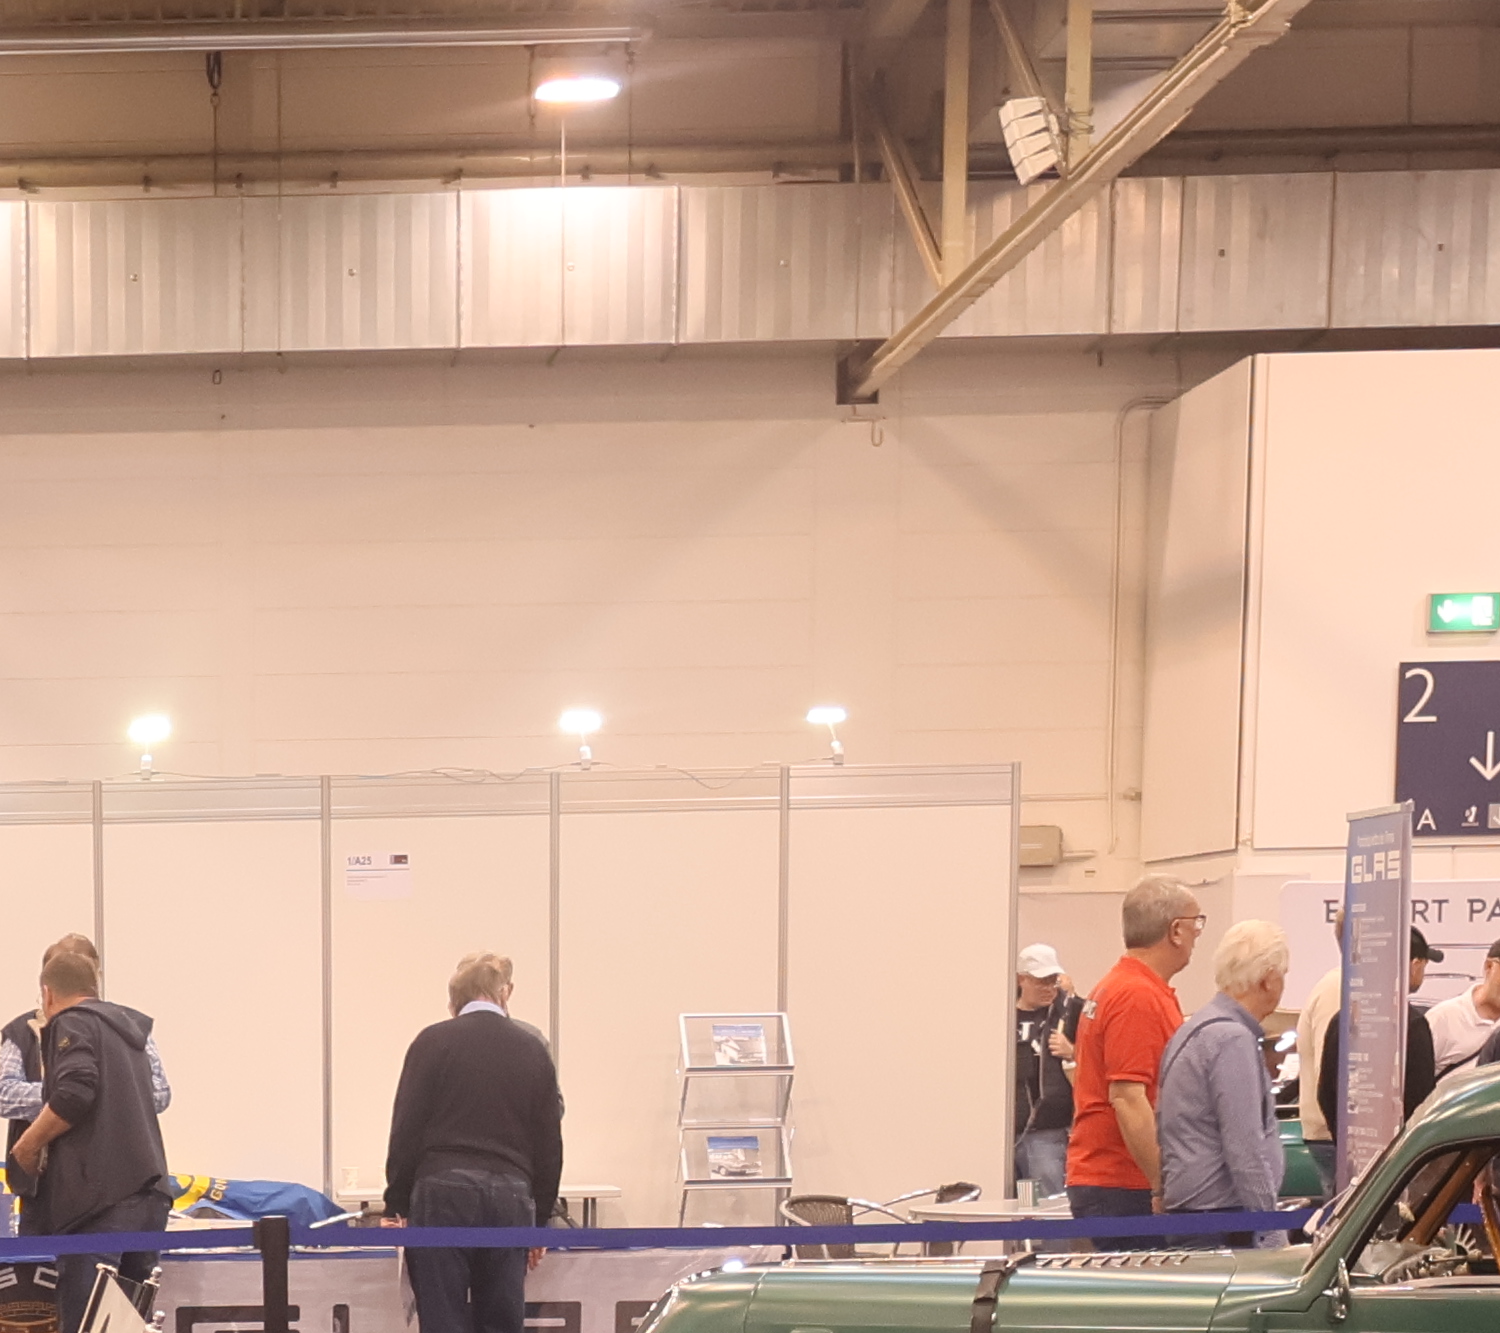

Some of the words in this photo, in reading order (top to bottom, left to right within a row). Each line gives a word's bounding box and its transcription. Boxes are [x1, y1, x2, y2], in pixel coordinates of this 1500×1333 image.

[1403, 668, 1437, 722] 2
[1416, 808, 1437, 831] A
[347, 855, 372, 866] 1/A25
[1351, 850, 1400, 884] GLAS
[1324, 899, 1449, 924] ERT
[33, 1266, 60, 1289] C
